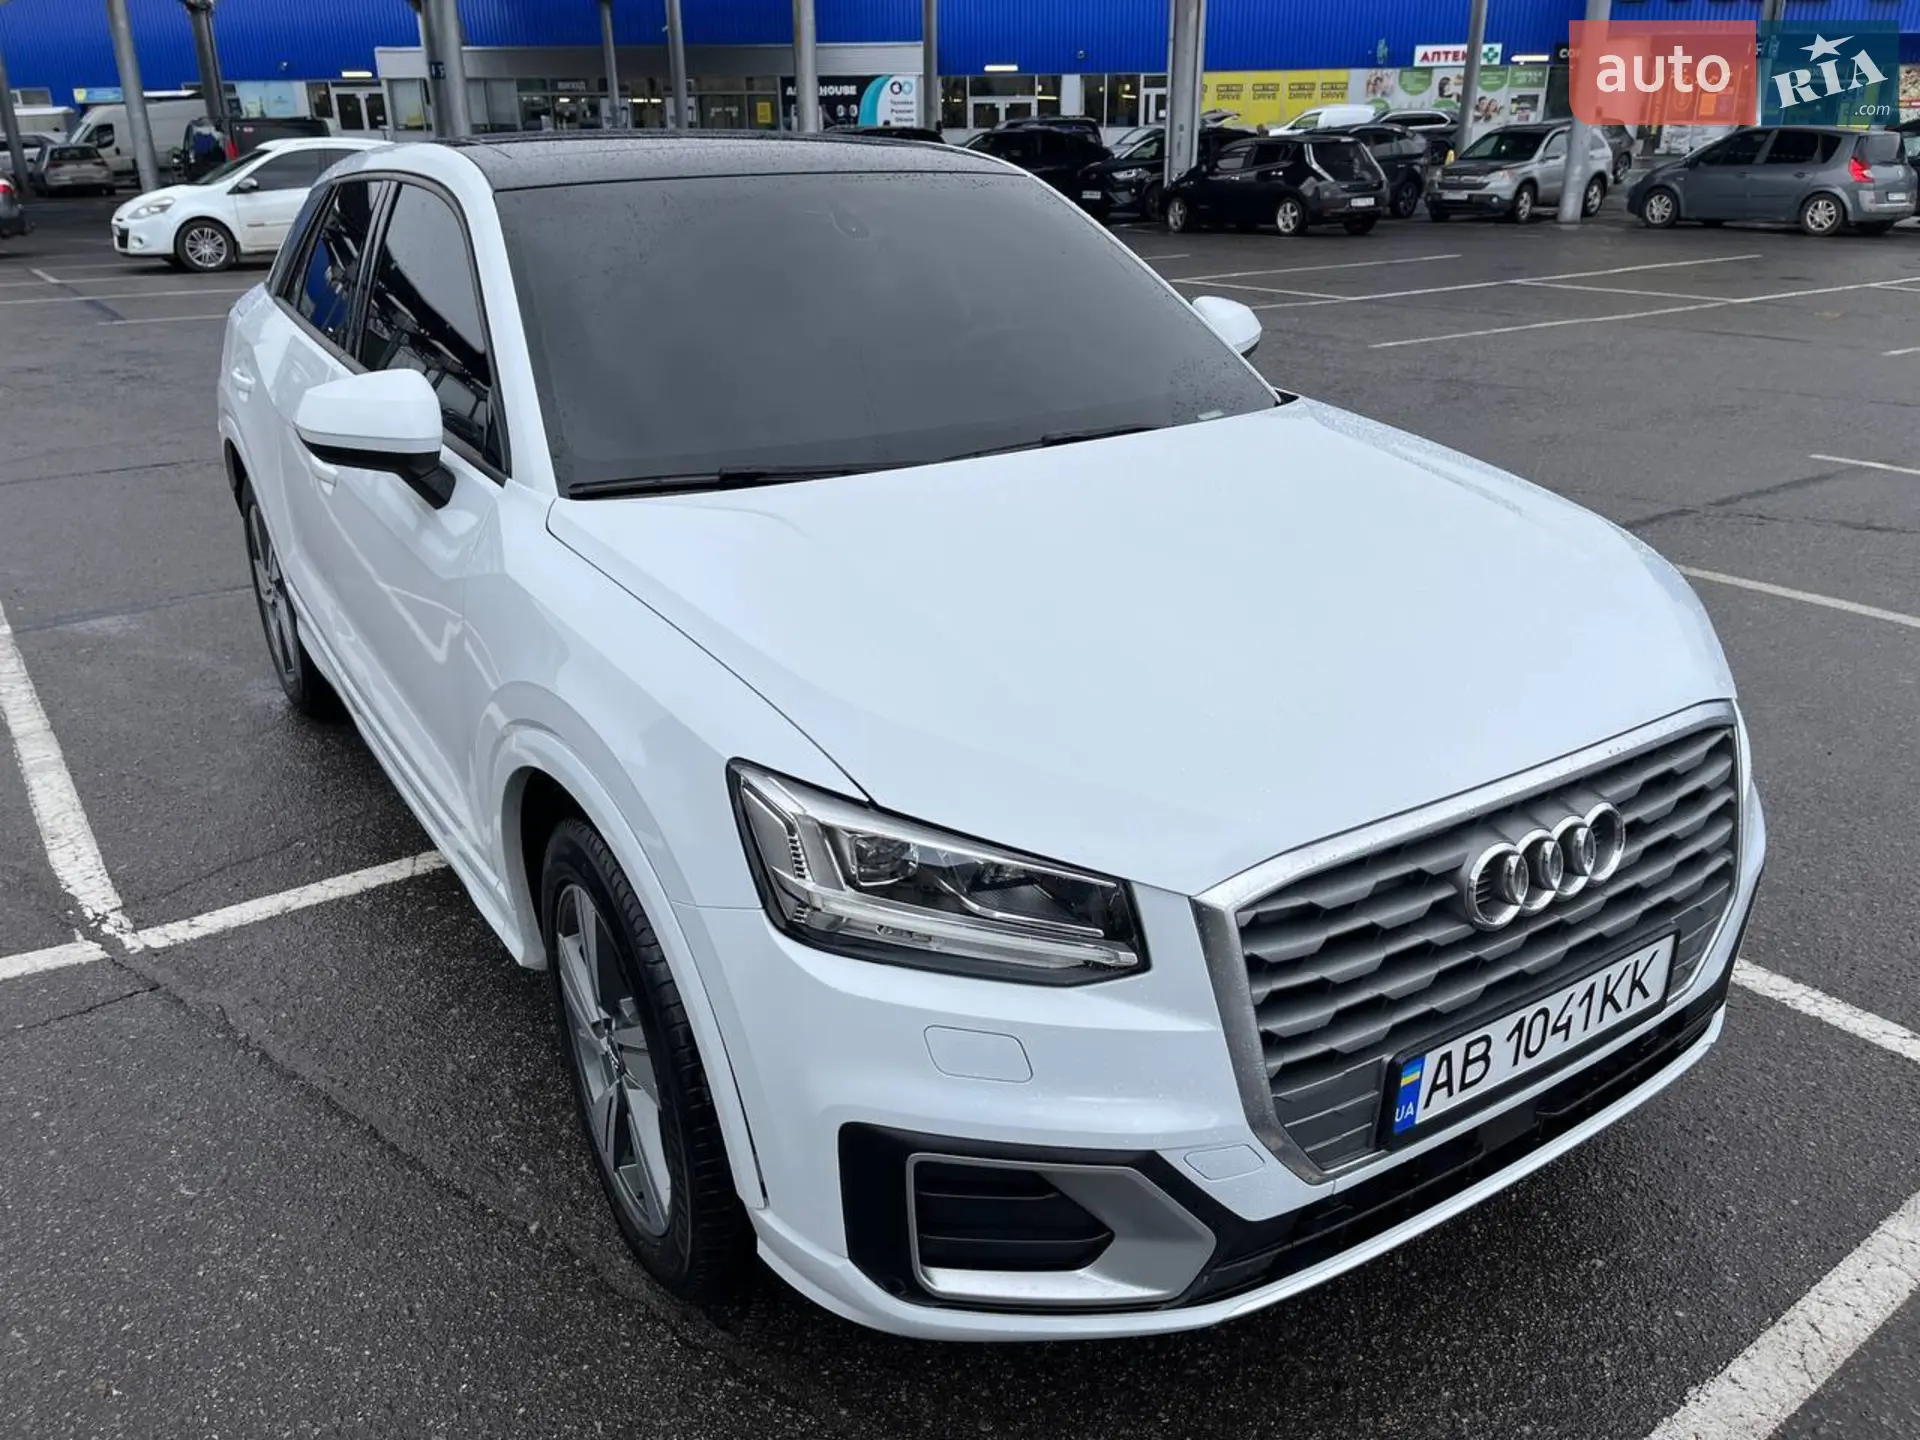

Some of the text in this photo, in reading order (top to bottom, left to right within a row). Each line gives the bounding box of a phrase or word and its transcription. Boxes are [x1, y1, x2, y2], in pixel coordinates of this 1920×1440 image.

[1420, 50, 1469, 62] АПТЕК
[819, 85, 857, 96] HOUSE
[1394, 1101, 1415, 1122] UA
